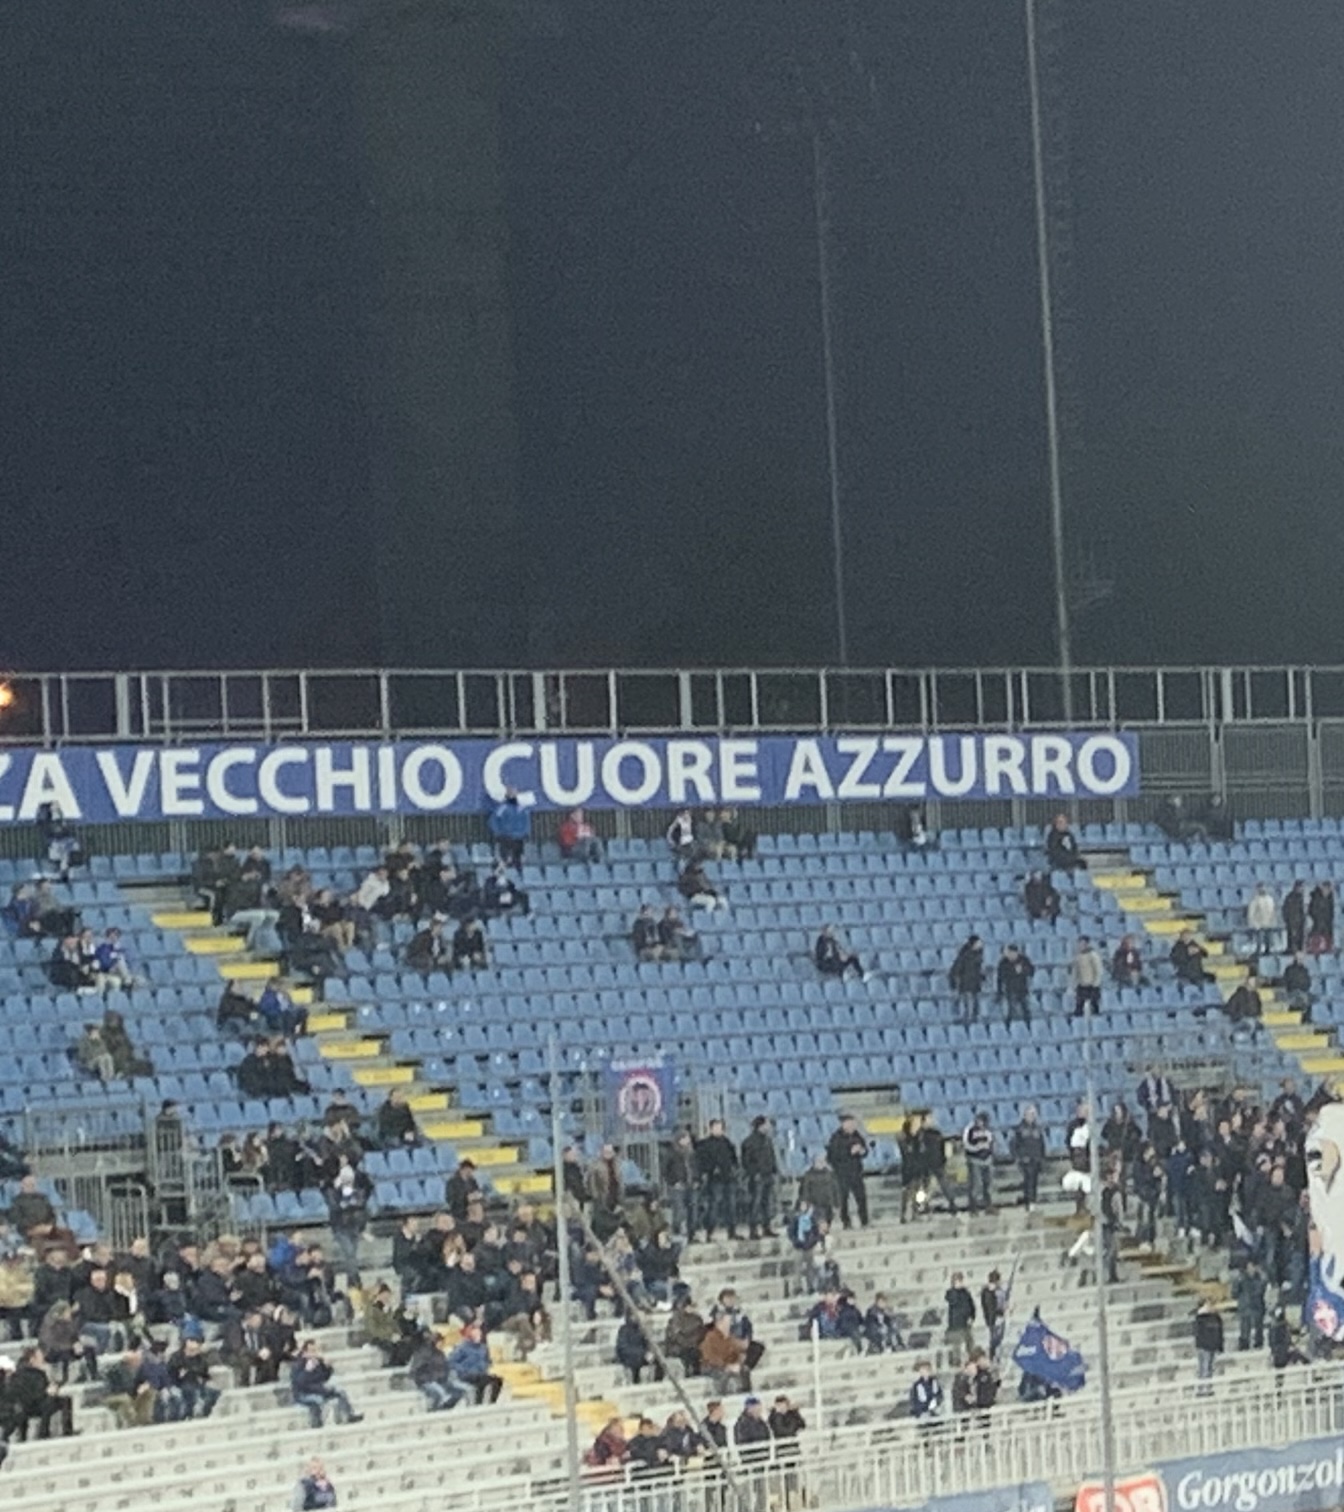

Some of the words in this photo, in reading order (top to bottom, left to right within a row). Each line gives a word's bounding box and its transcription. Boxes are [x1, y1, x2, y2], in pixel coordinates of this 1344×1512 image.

[96, 742, 463, 818] VECCHIO
[483, 736, 761, 805] CUORE
[784, 734, 1131, 799] AZZURRO
